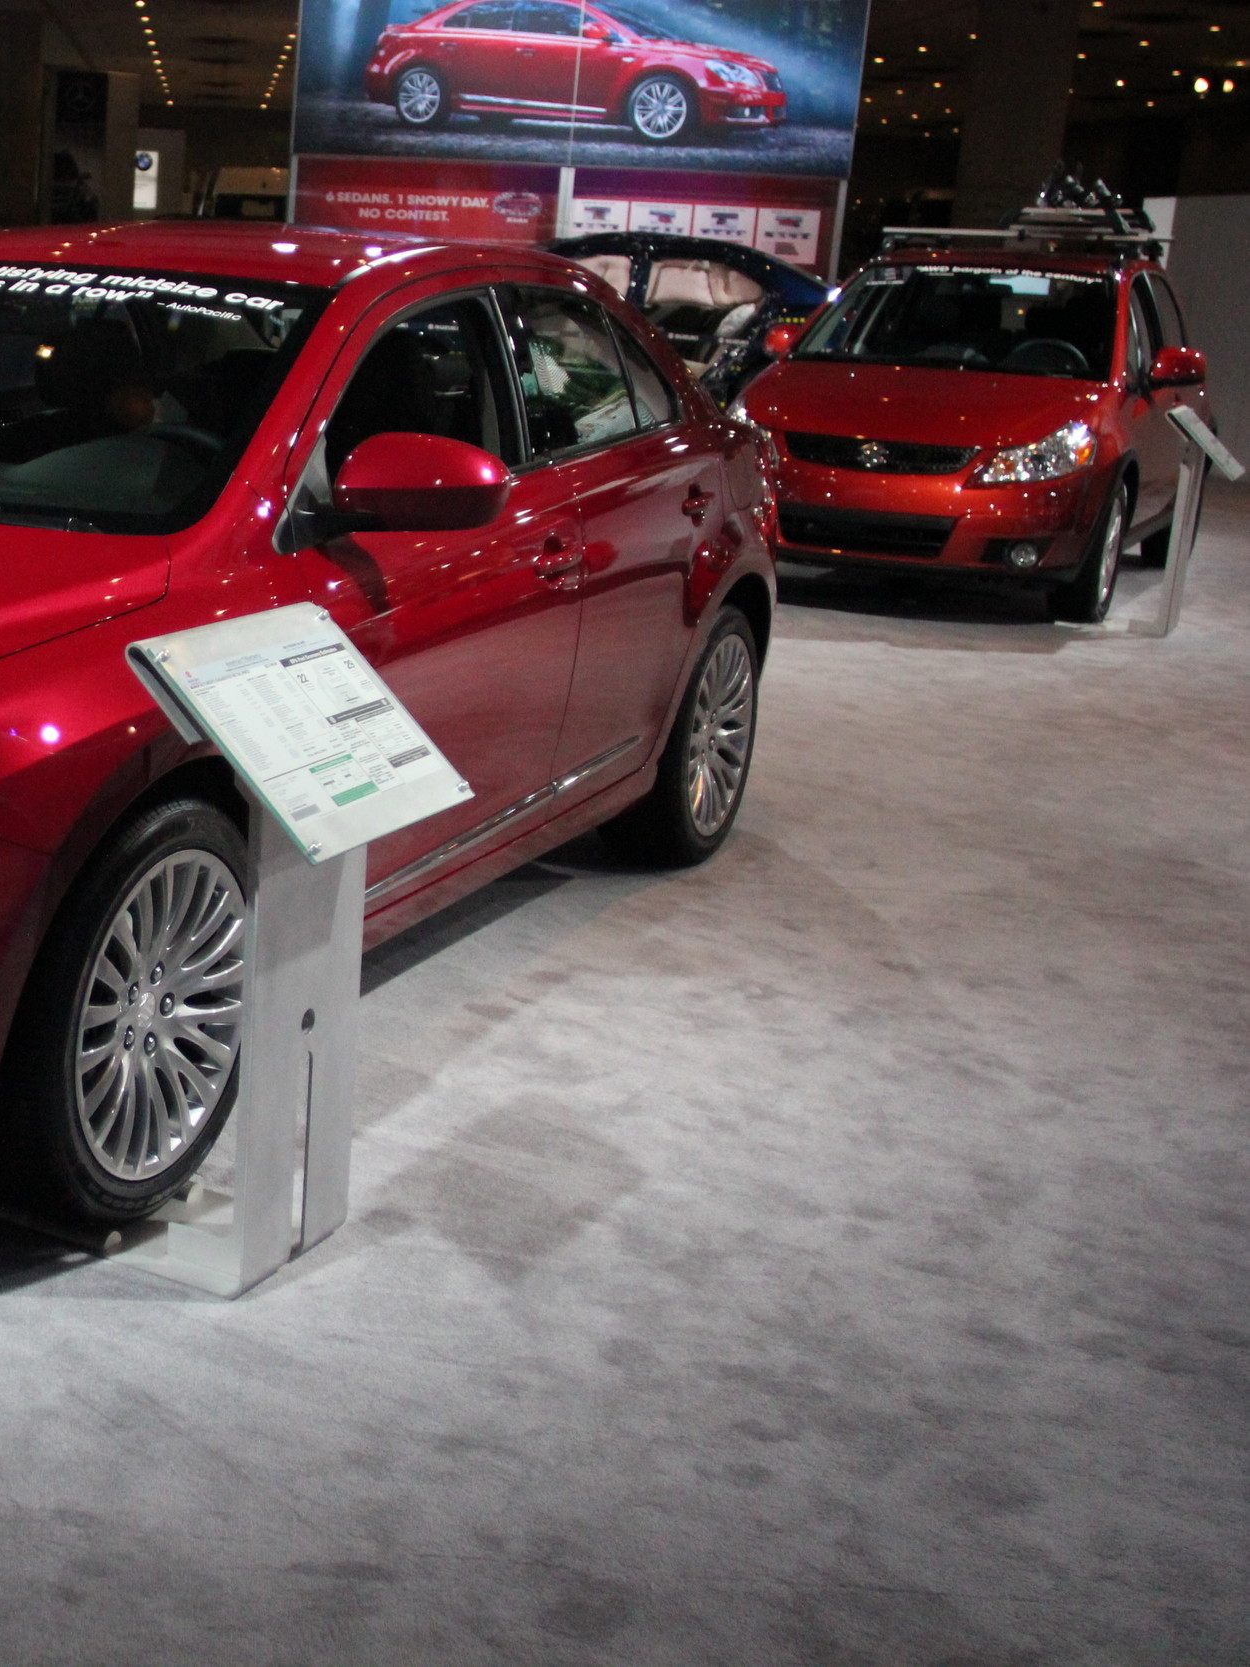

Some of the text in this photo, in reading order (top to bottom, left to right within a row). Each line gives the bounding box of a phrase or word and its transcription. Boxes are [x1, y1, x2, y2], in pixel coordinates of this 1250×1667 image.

[326, 191, 489, 208] 6 SEDANS. 1 SNOWY DAY.
[358, 208, 450, 222] NO CONTEST.
[952, 266, 1002, 275] bargain
[1021, 269, 1043, 277] the
[8, 278, 39, 292] in
[44, 283, 70, 296] a
[100, 274, 218, 298] midsize
[224, 291, 285, 311] car
[166, 302, 242, 321] AutoPacific
